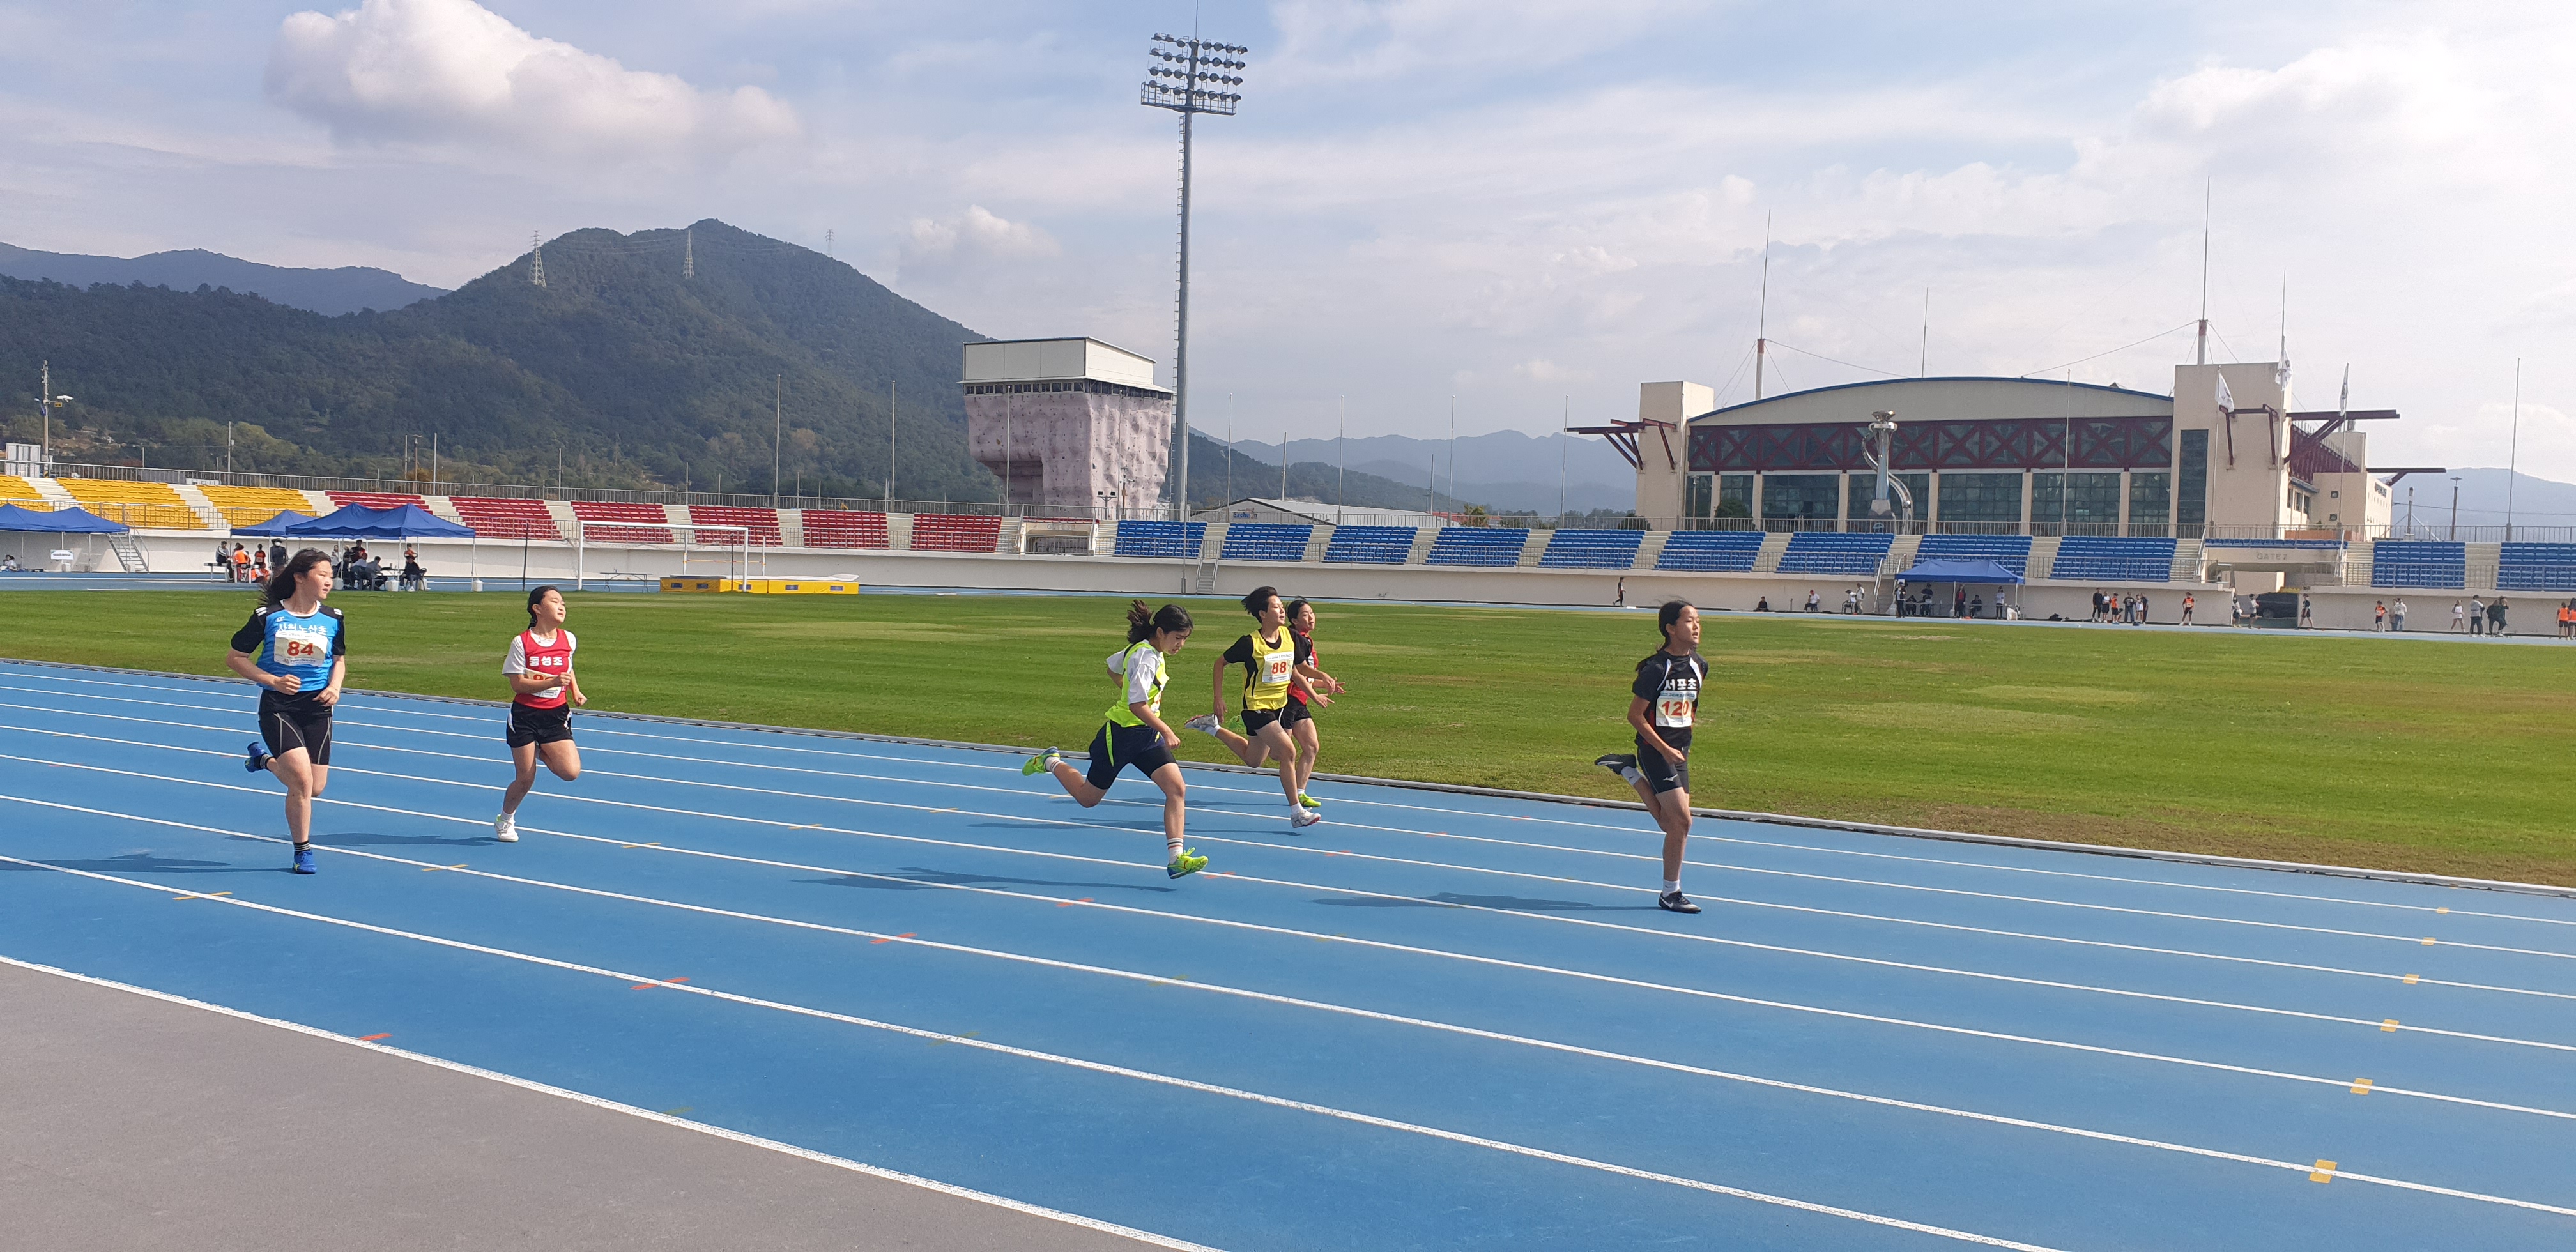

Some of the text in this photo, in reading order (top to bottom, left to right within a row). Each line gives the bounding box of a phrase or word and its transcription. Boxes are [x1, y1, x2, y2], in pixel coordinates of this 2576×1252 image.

[287, 641, 314, 656] 84
[529, 656, 564, 666] 동성초
[1271, 661, 1287, 674] 88
[1664, 678, 1697, 691] 서포초
[1662, 700, 1689, 716] 120
